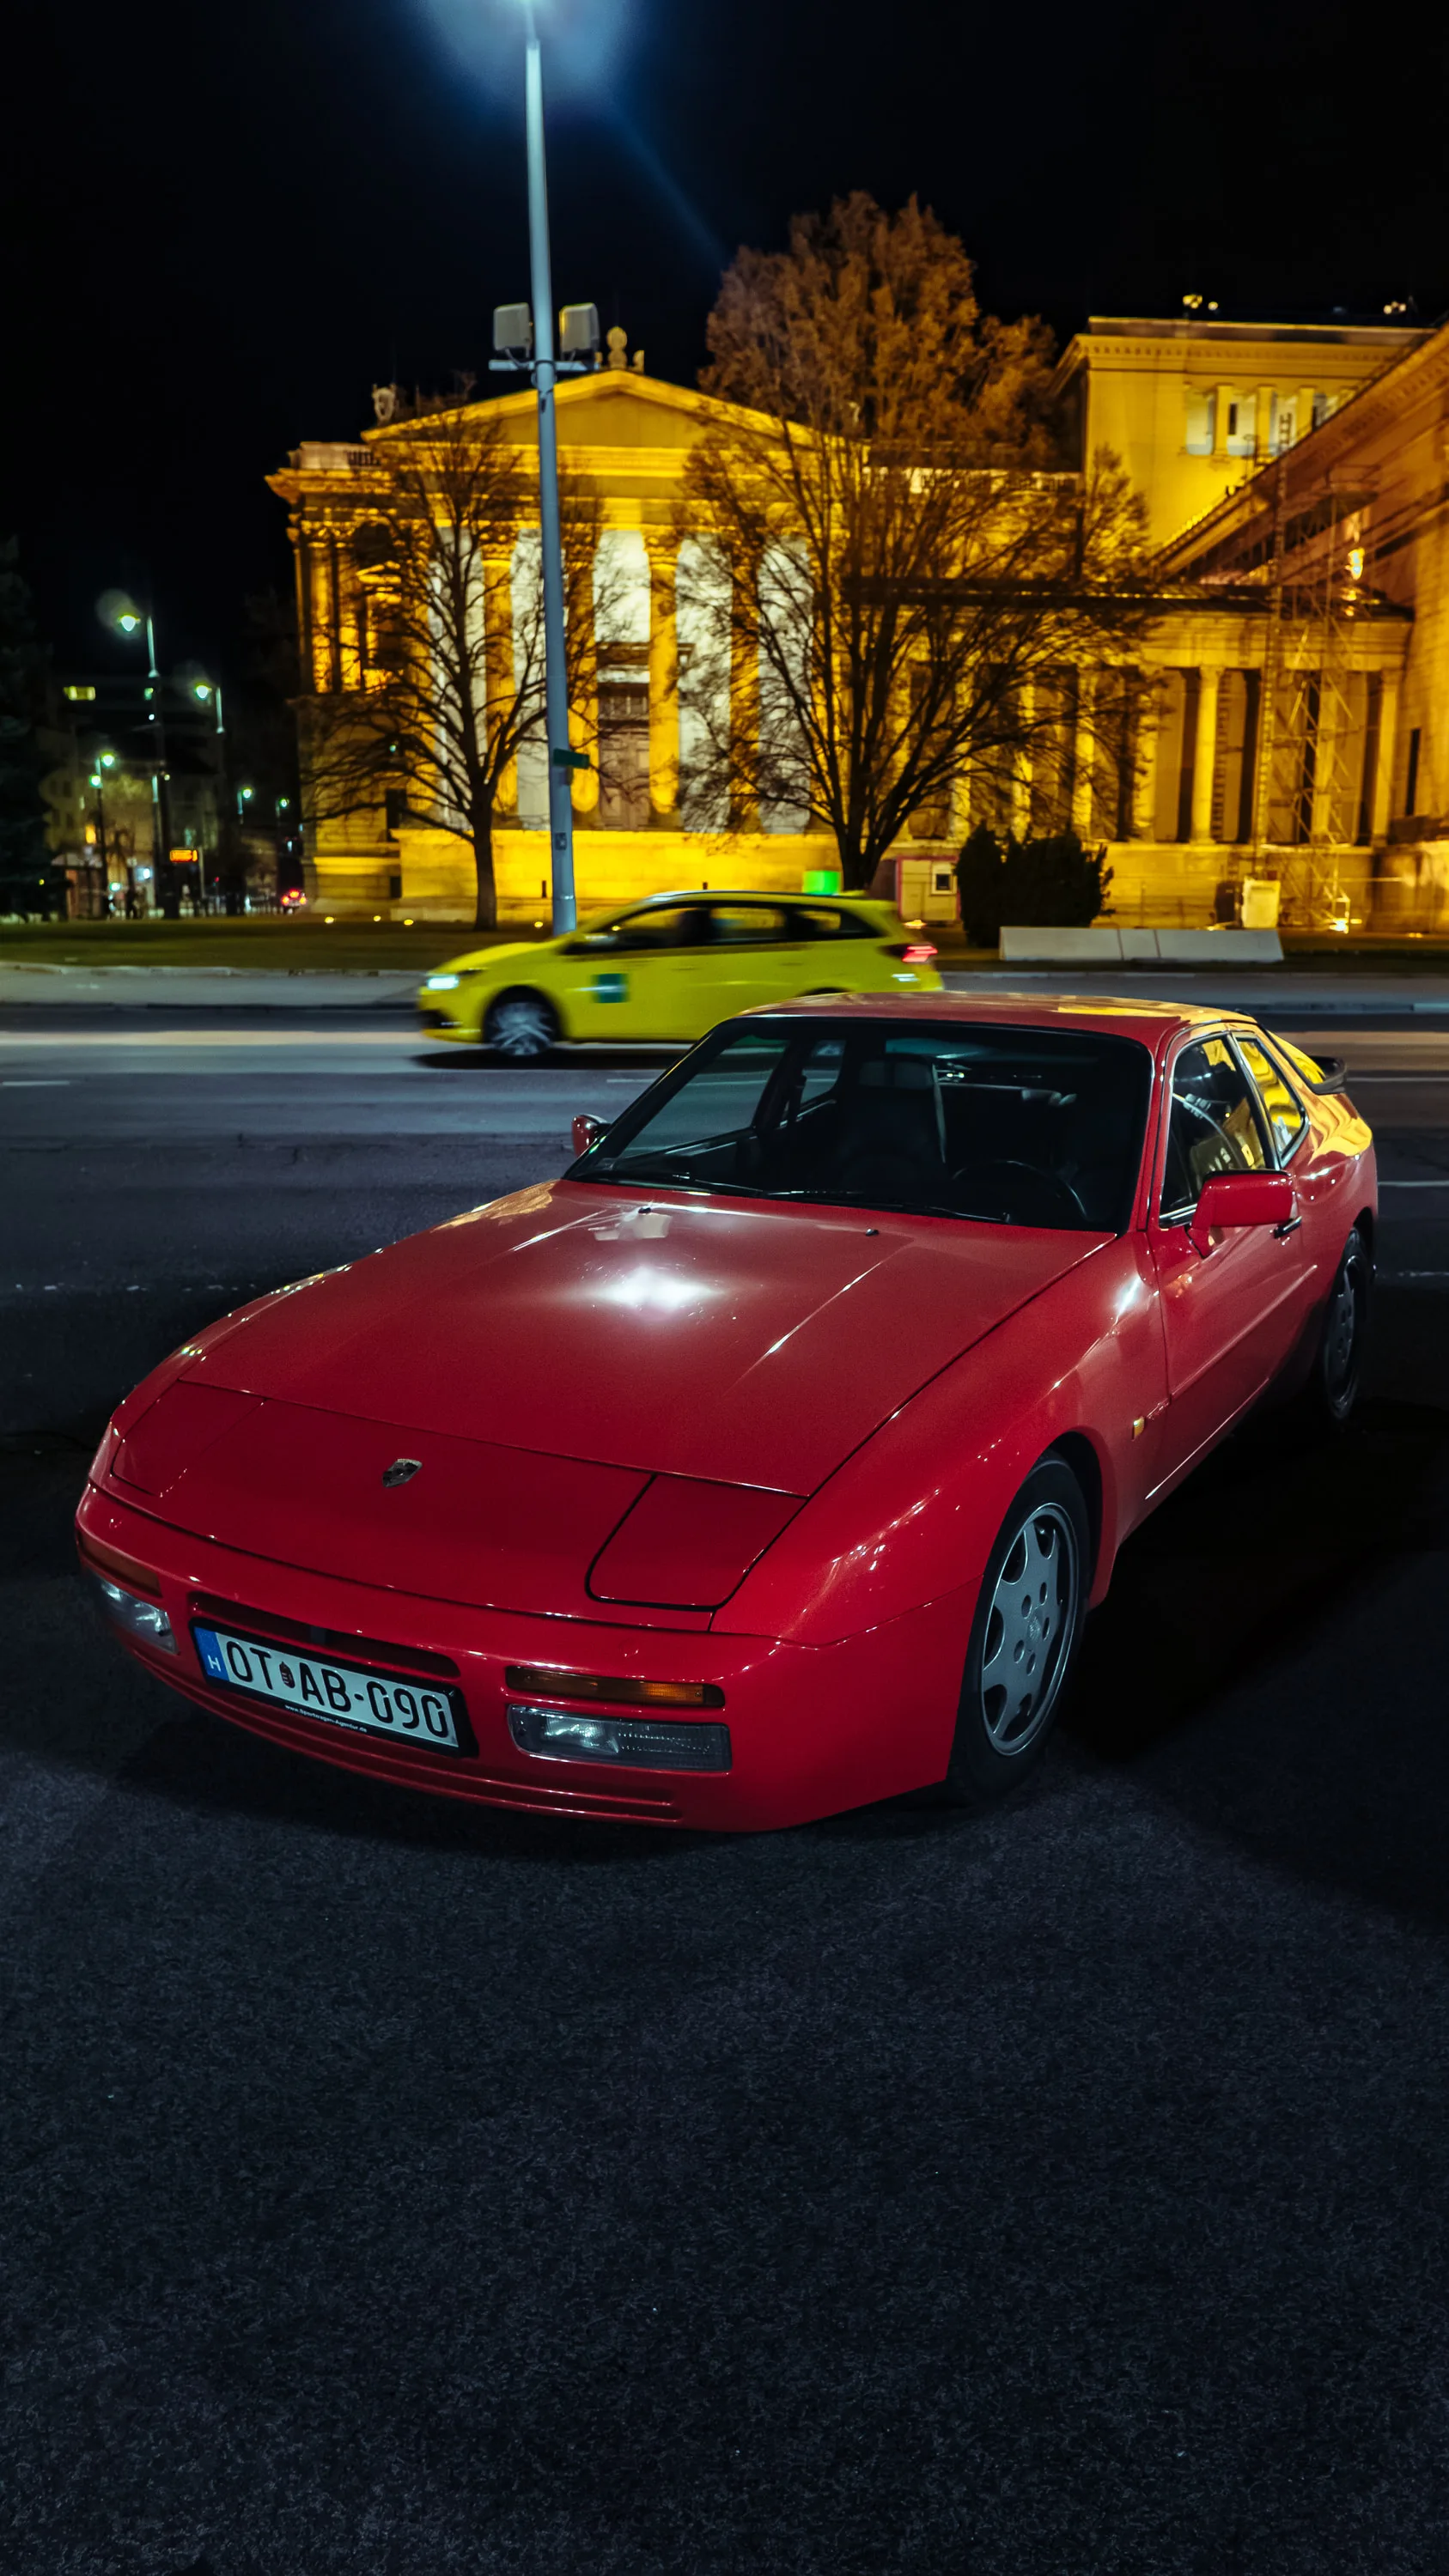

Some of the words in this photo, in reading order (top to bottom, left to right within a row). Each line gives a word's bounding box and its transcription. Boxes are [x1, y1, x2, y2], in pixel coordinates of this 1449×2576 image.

[209, 1654, 221, 1673] H
[226, 1640, 274, 1691] OT
[299, 1662, 449, 1739] AB-090
